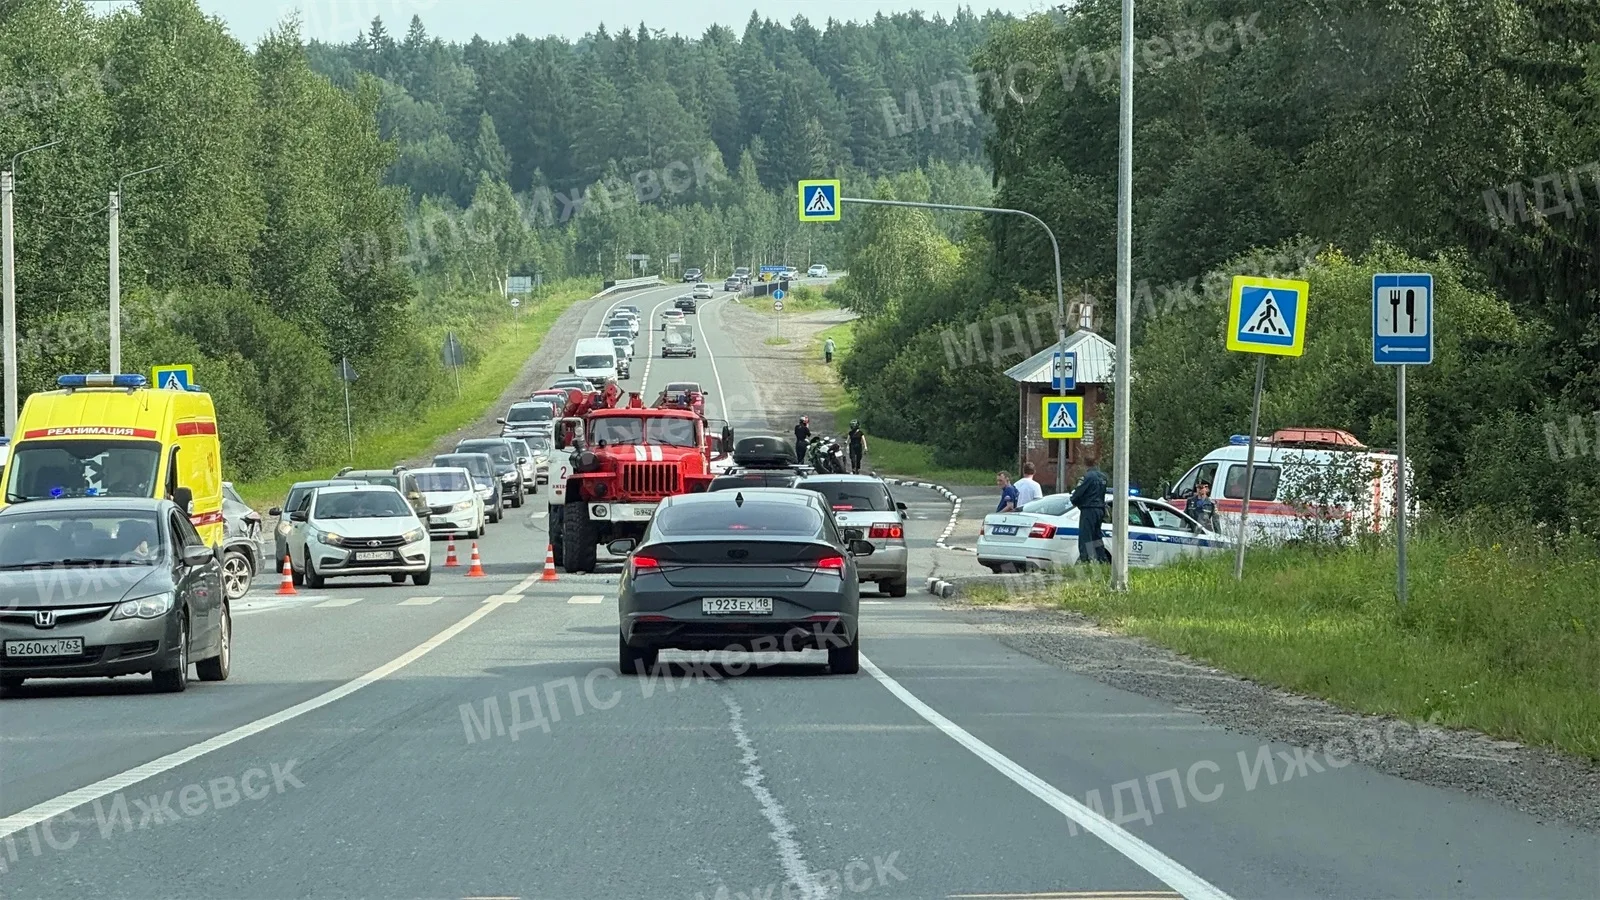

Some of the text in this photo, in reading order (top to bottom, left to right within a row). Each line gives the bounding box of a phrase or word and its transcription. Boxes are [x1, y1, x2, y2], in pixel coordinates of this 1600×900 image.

[47, 427, 134, 436] РЕАНИМАЦИЯ
[560, 466, 567, 479] 2
[1132, 541, 1143, 551] 85
[707, 598, 769, 610] Т923ЕХ 18
[10, 640, 79, 655] В260КХ 763
